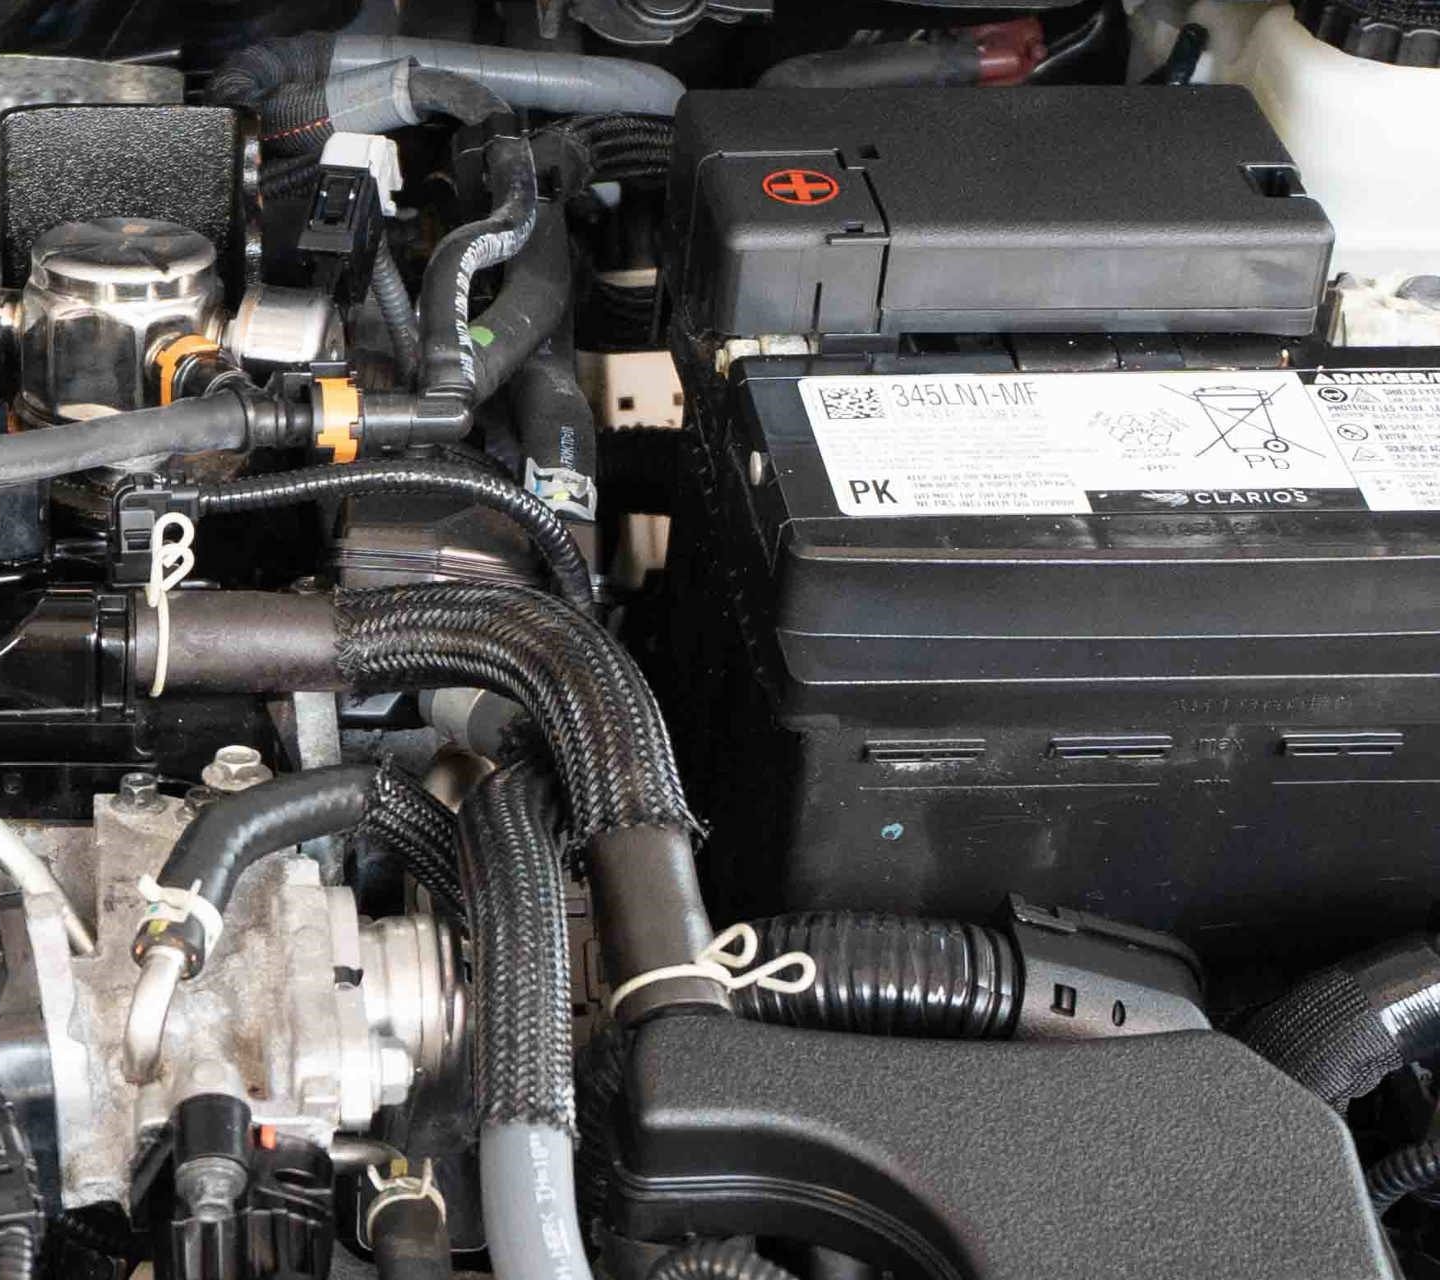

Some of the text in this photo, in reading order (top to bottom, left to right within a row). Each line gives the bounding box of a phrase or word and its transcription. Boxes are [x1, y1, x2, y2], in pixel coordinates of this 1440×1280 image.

[892, 382, 1039, 407] 345LN1-MF
[1244, 454, 1290, 469] Pb
[849, 479, 898, 504] PK
[1195, 490, 1308, 504] CLARIOS
